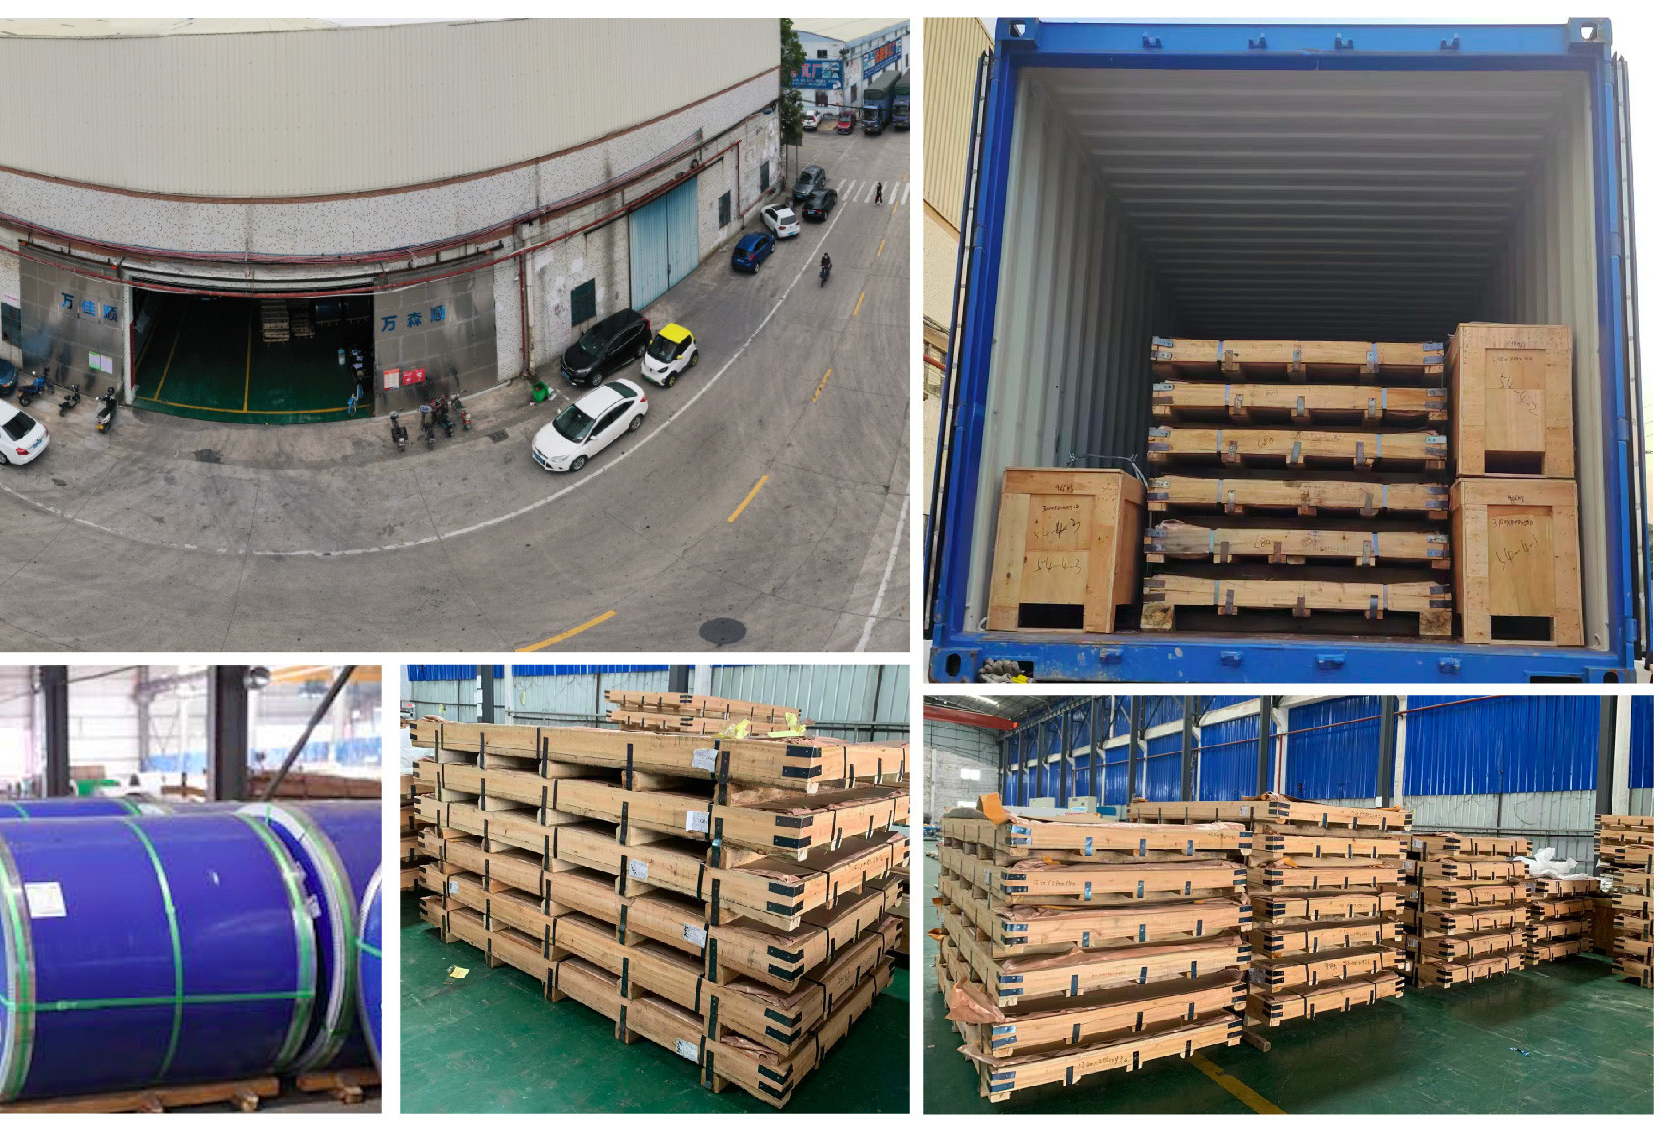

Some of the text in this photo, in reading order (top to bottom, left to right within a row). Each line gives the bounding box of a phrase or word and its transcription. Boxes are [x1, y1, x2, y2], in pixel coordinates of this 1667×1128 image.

[61, 292, 118, 322] 万佳顺
[381, 304, 446, 333] 万森顺
